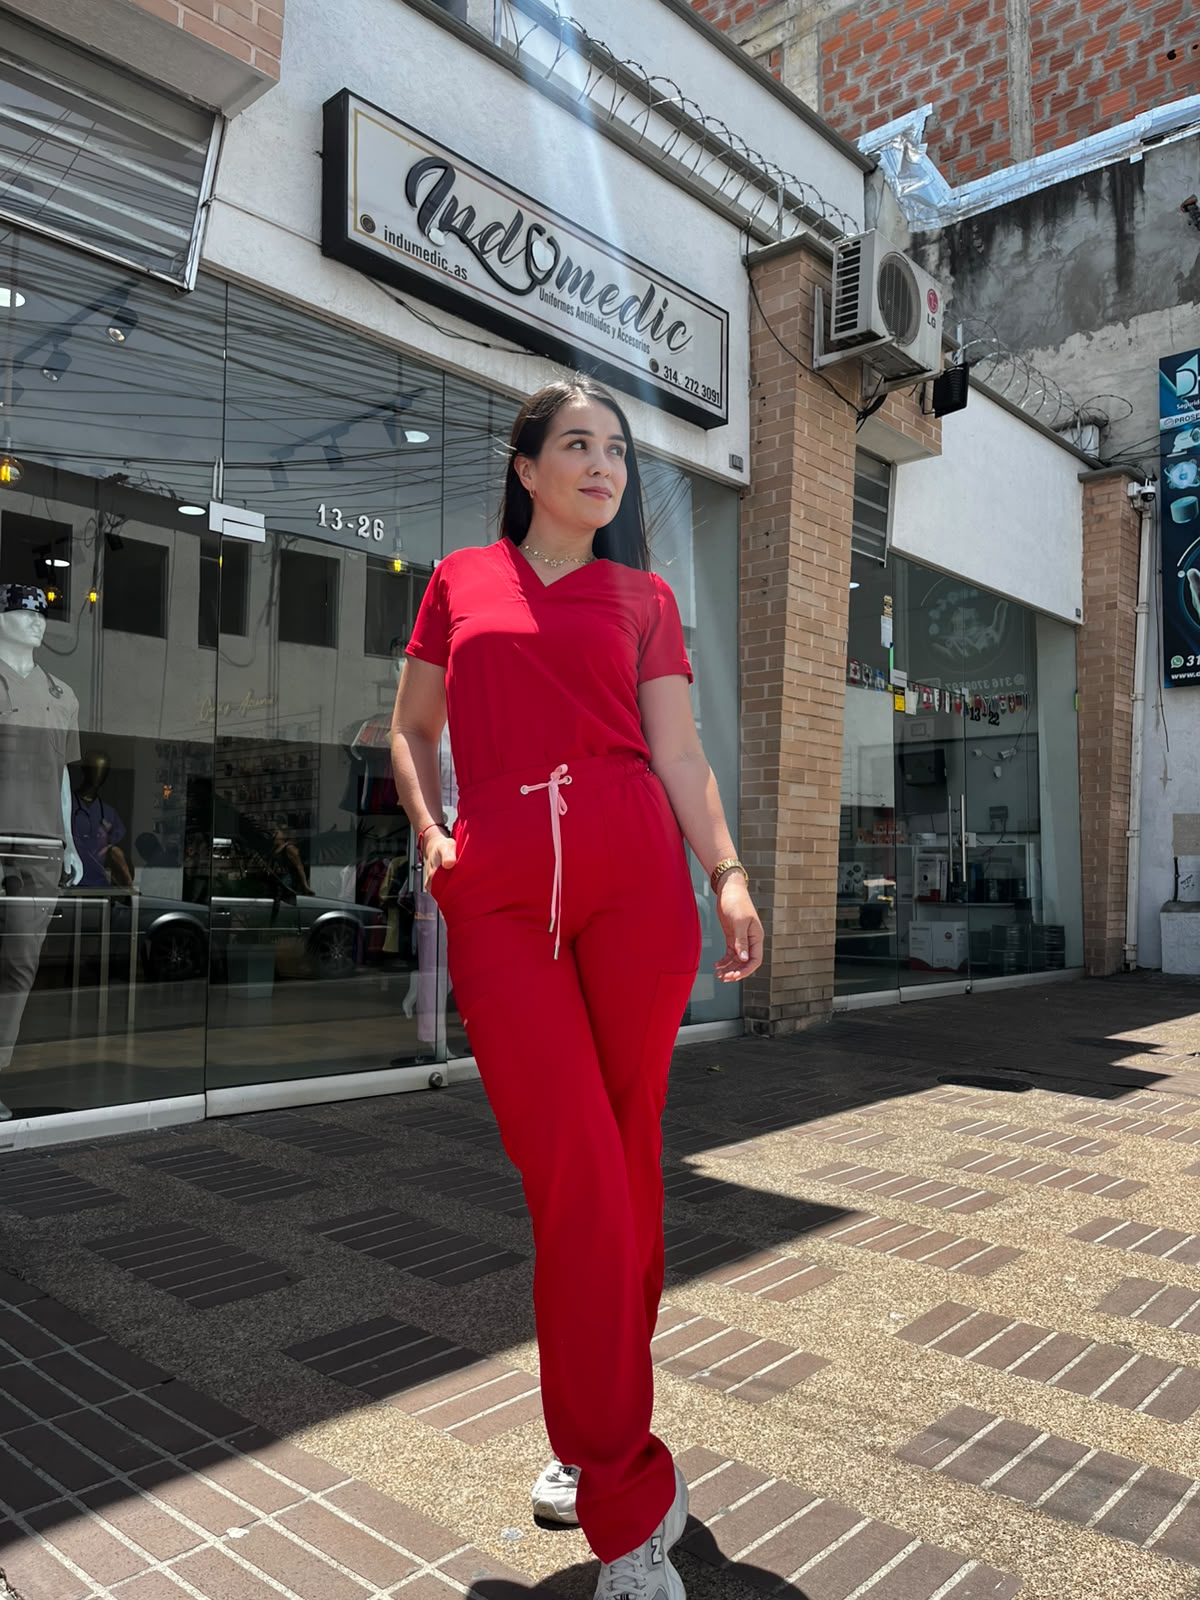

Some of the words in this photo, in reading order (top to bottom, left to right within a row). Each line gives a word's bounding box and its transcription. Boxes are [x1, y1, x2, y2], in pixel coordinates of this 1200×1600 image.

[384, 225, 468, 280] indumedic_as
[540, 287, 574, 316] Uniformes
[575, 306, 611, 335] Antifluidos
[611, 327, 617, 339] y
[617, 328, 651, 354] Accesorios
[927, 313, 937, 329] LG
[685, 376, 699, 394] 272
[702, 385, 720, 404] 3091
[317, 503, 384, 541] 13-26
